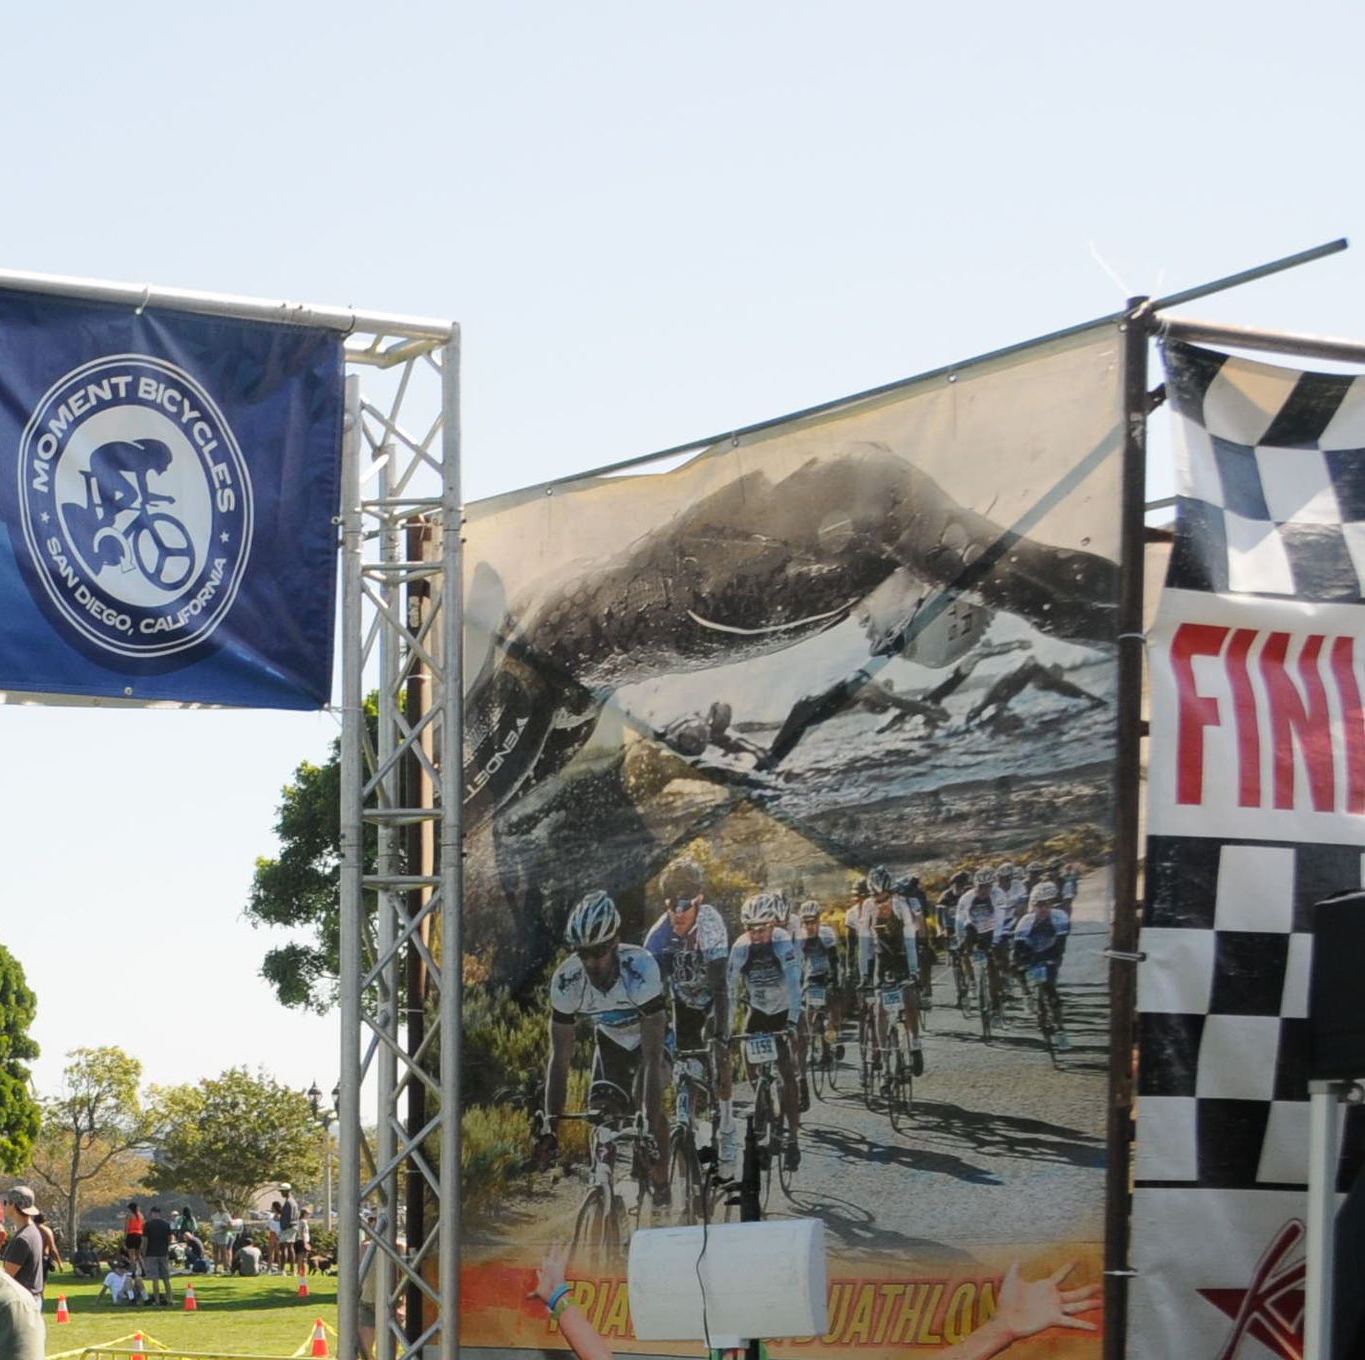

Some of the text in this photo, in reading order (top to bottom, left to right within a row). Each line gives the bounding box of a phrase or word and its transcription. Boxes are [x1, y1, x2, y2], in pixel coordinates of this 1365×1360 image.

[32, 374, 236, 514] MOMENT BICYCLES
[46, 535, 227, 636] SAN DIEGO, CALIFORNIA
